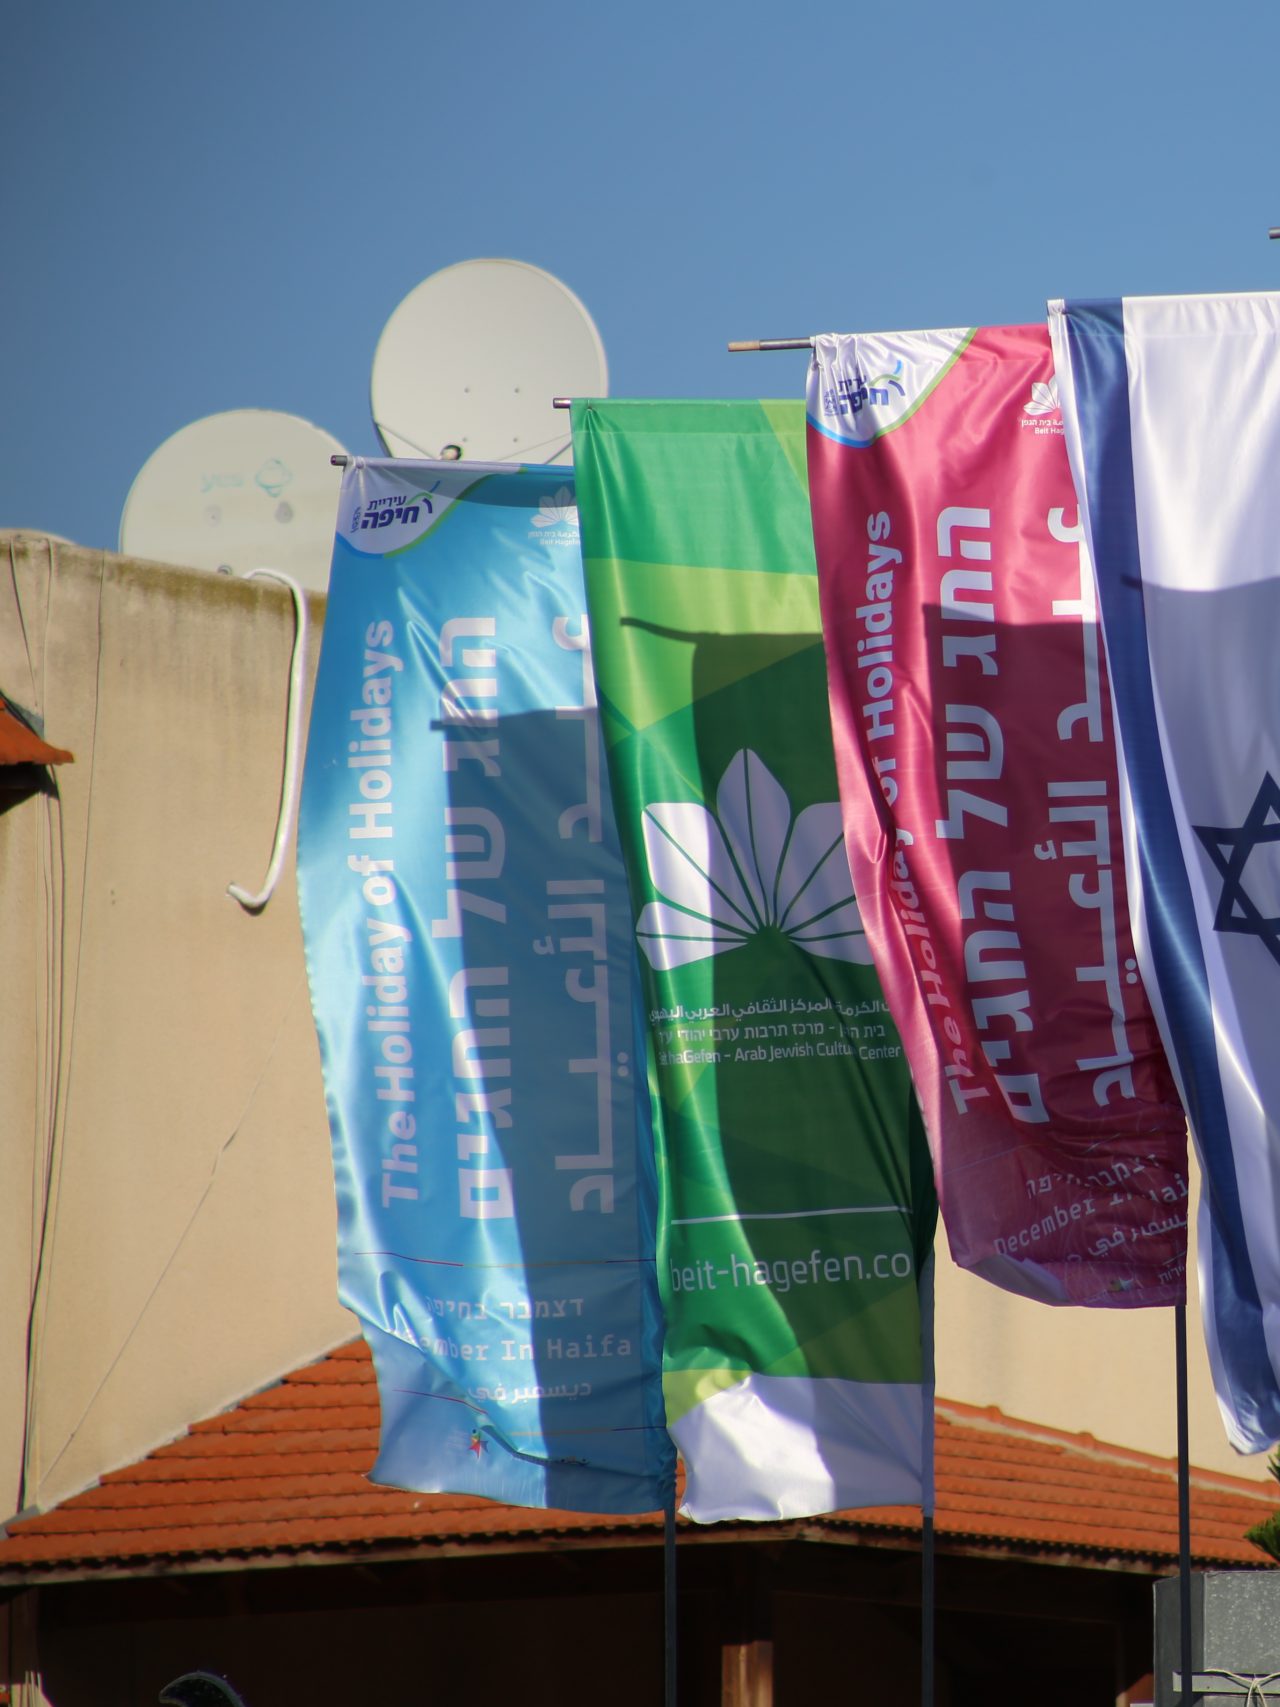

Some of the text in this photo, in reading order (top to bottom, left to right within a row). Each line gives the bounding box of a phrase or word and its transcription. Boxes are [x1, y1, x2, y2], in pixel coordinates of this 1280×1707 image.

[366, 495, 408, 511] עיריית
[360, 505, 420, 529] חיפה
[856, 510, 903, 742] Holidays
[935, 505, 1050, 1124] החג של החגים
[347, 619, 420, 1208] The Holiday of Holidays
[431, 617, 516, 1220] החג של החגים
[791, 1022, 825, 1036] מרכז
[864, 1024, 886, 1039] בית
[734, 1046, 767, 1062] Arab
[769, 1041, 814, 1063] Jewish
[816, 1040, 853, 1057] Cultu
[858, 1045, 902, 1061] Center
[993, 1197, 1097, 1256] December
[670, 1250, 912, 1293] beit-hagefen.co
[501, 1298, 584, 1320] דצמבר
[501, 1340, 535, 1361] In
[546, 1334, 633, 1360] Haifa
